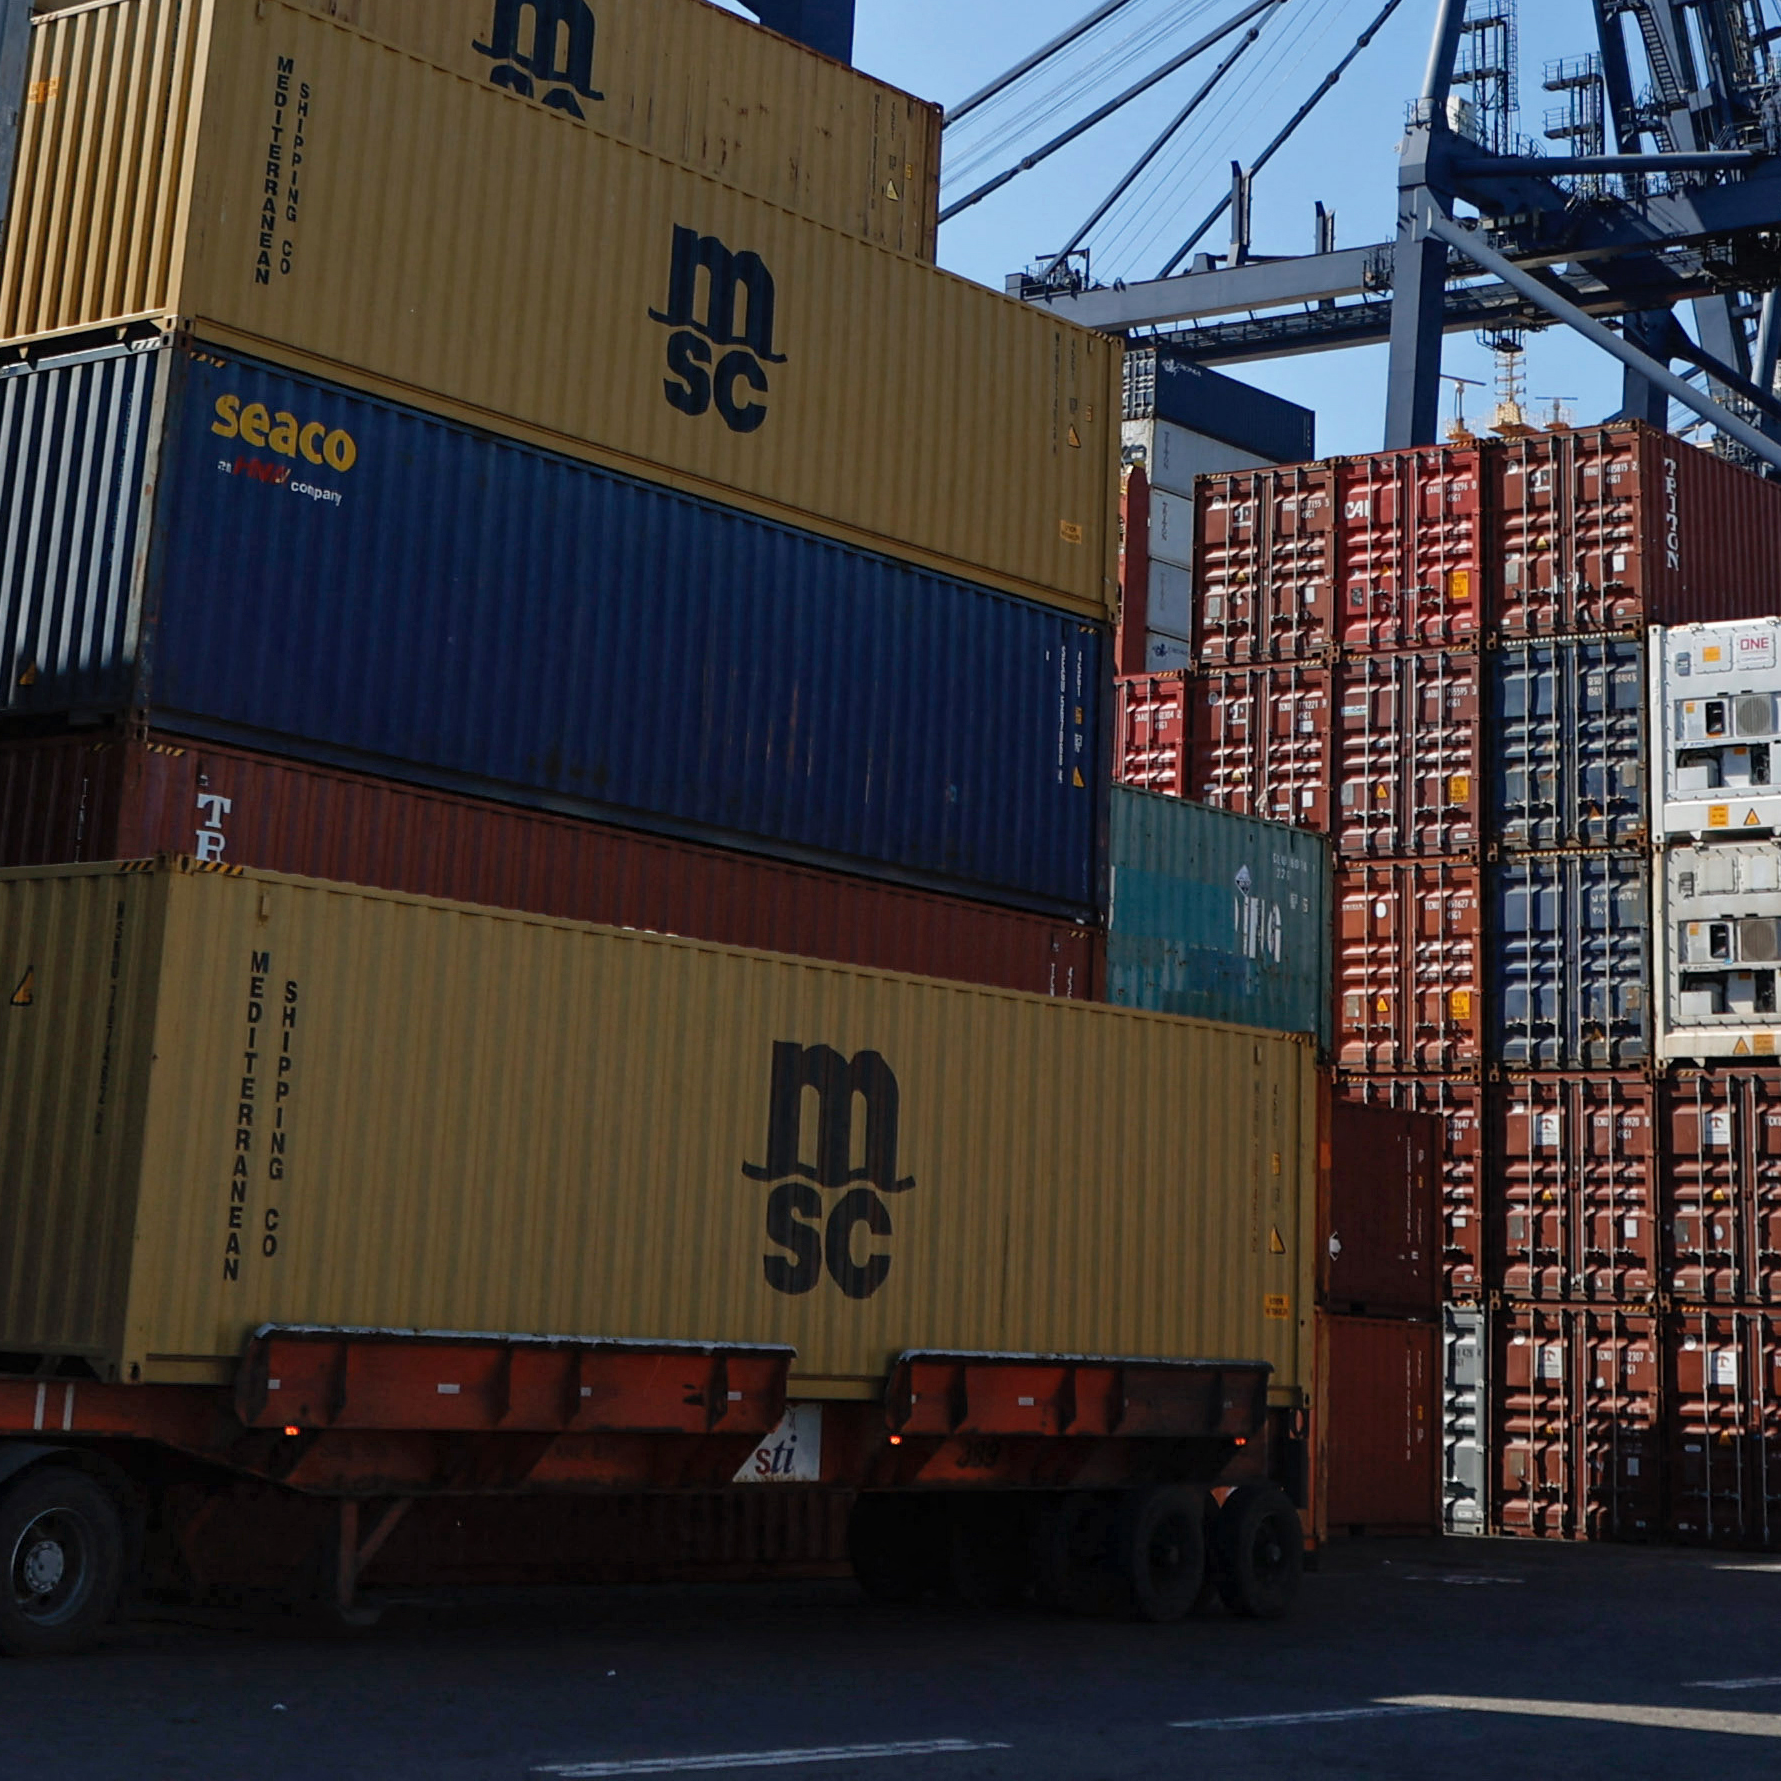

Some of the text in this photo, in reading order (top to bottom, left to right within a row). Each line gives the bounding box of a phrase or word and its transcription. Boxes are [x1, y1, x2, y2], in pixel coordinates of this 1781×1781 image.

[255, 55, 293, 285] MEDITERRANEAN
[280, 82, 310, 275] SHIPPING CO
[211, 394, 357, 472] seaco
[291, 481, 342, 506] company
[1664, 458, 1679, 571] TRITON
[1741, 638, 1768, 650] ONE
[222, 951, 270, 1281] MEDITERRANEAN
[262, 980, 298, 1258] SHIPPING CO
[755, 1435, 797, 1475] sti
